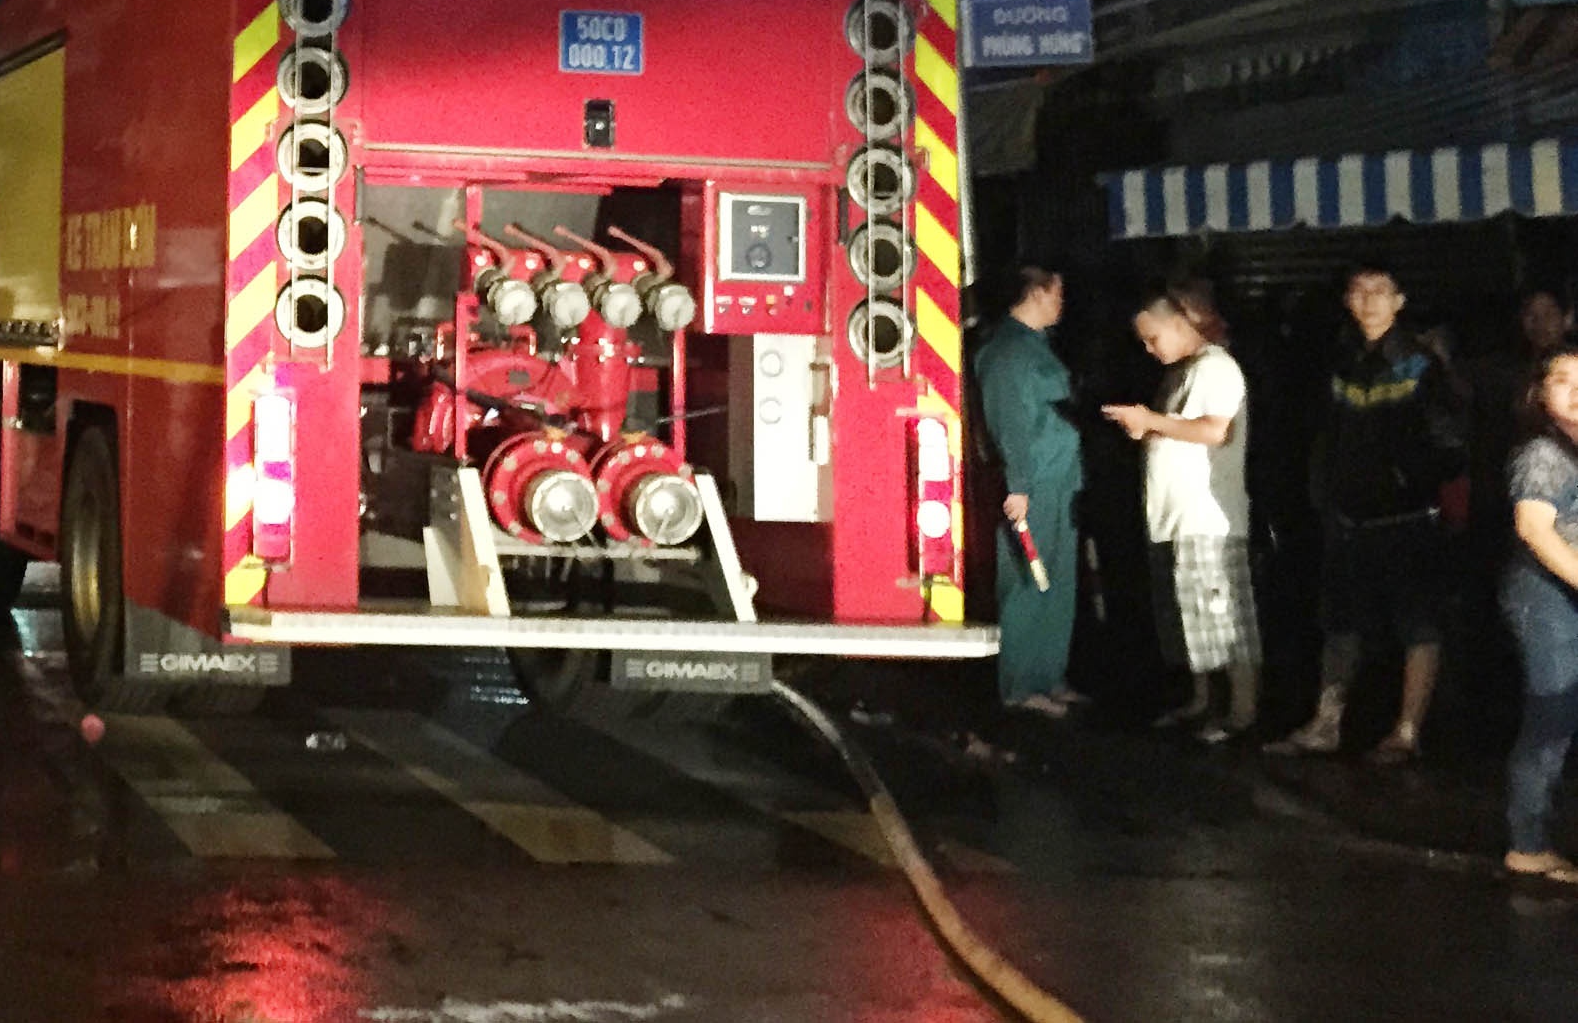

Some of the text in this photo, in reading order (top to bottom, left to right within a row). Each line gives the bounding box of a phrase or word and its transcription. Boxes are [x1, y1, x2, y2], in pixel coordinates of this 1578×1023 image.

[568, 43, 636, 70] 000.12
[160, 653, 256, 673] GIMAEX
[645, 659, 739, 681] GIMAEX
